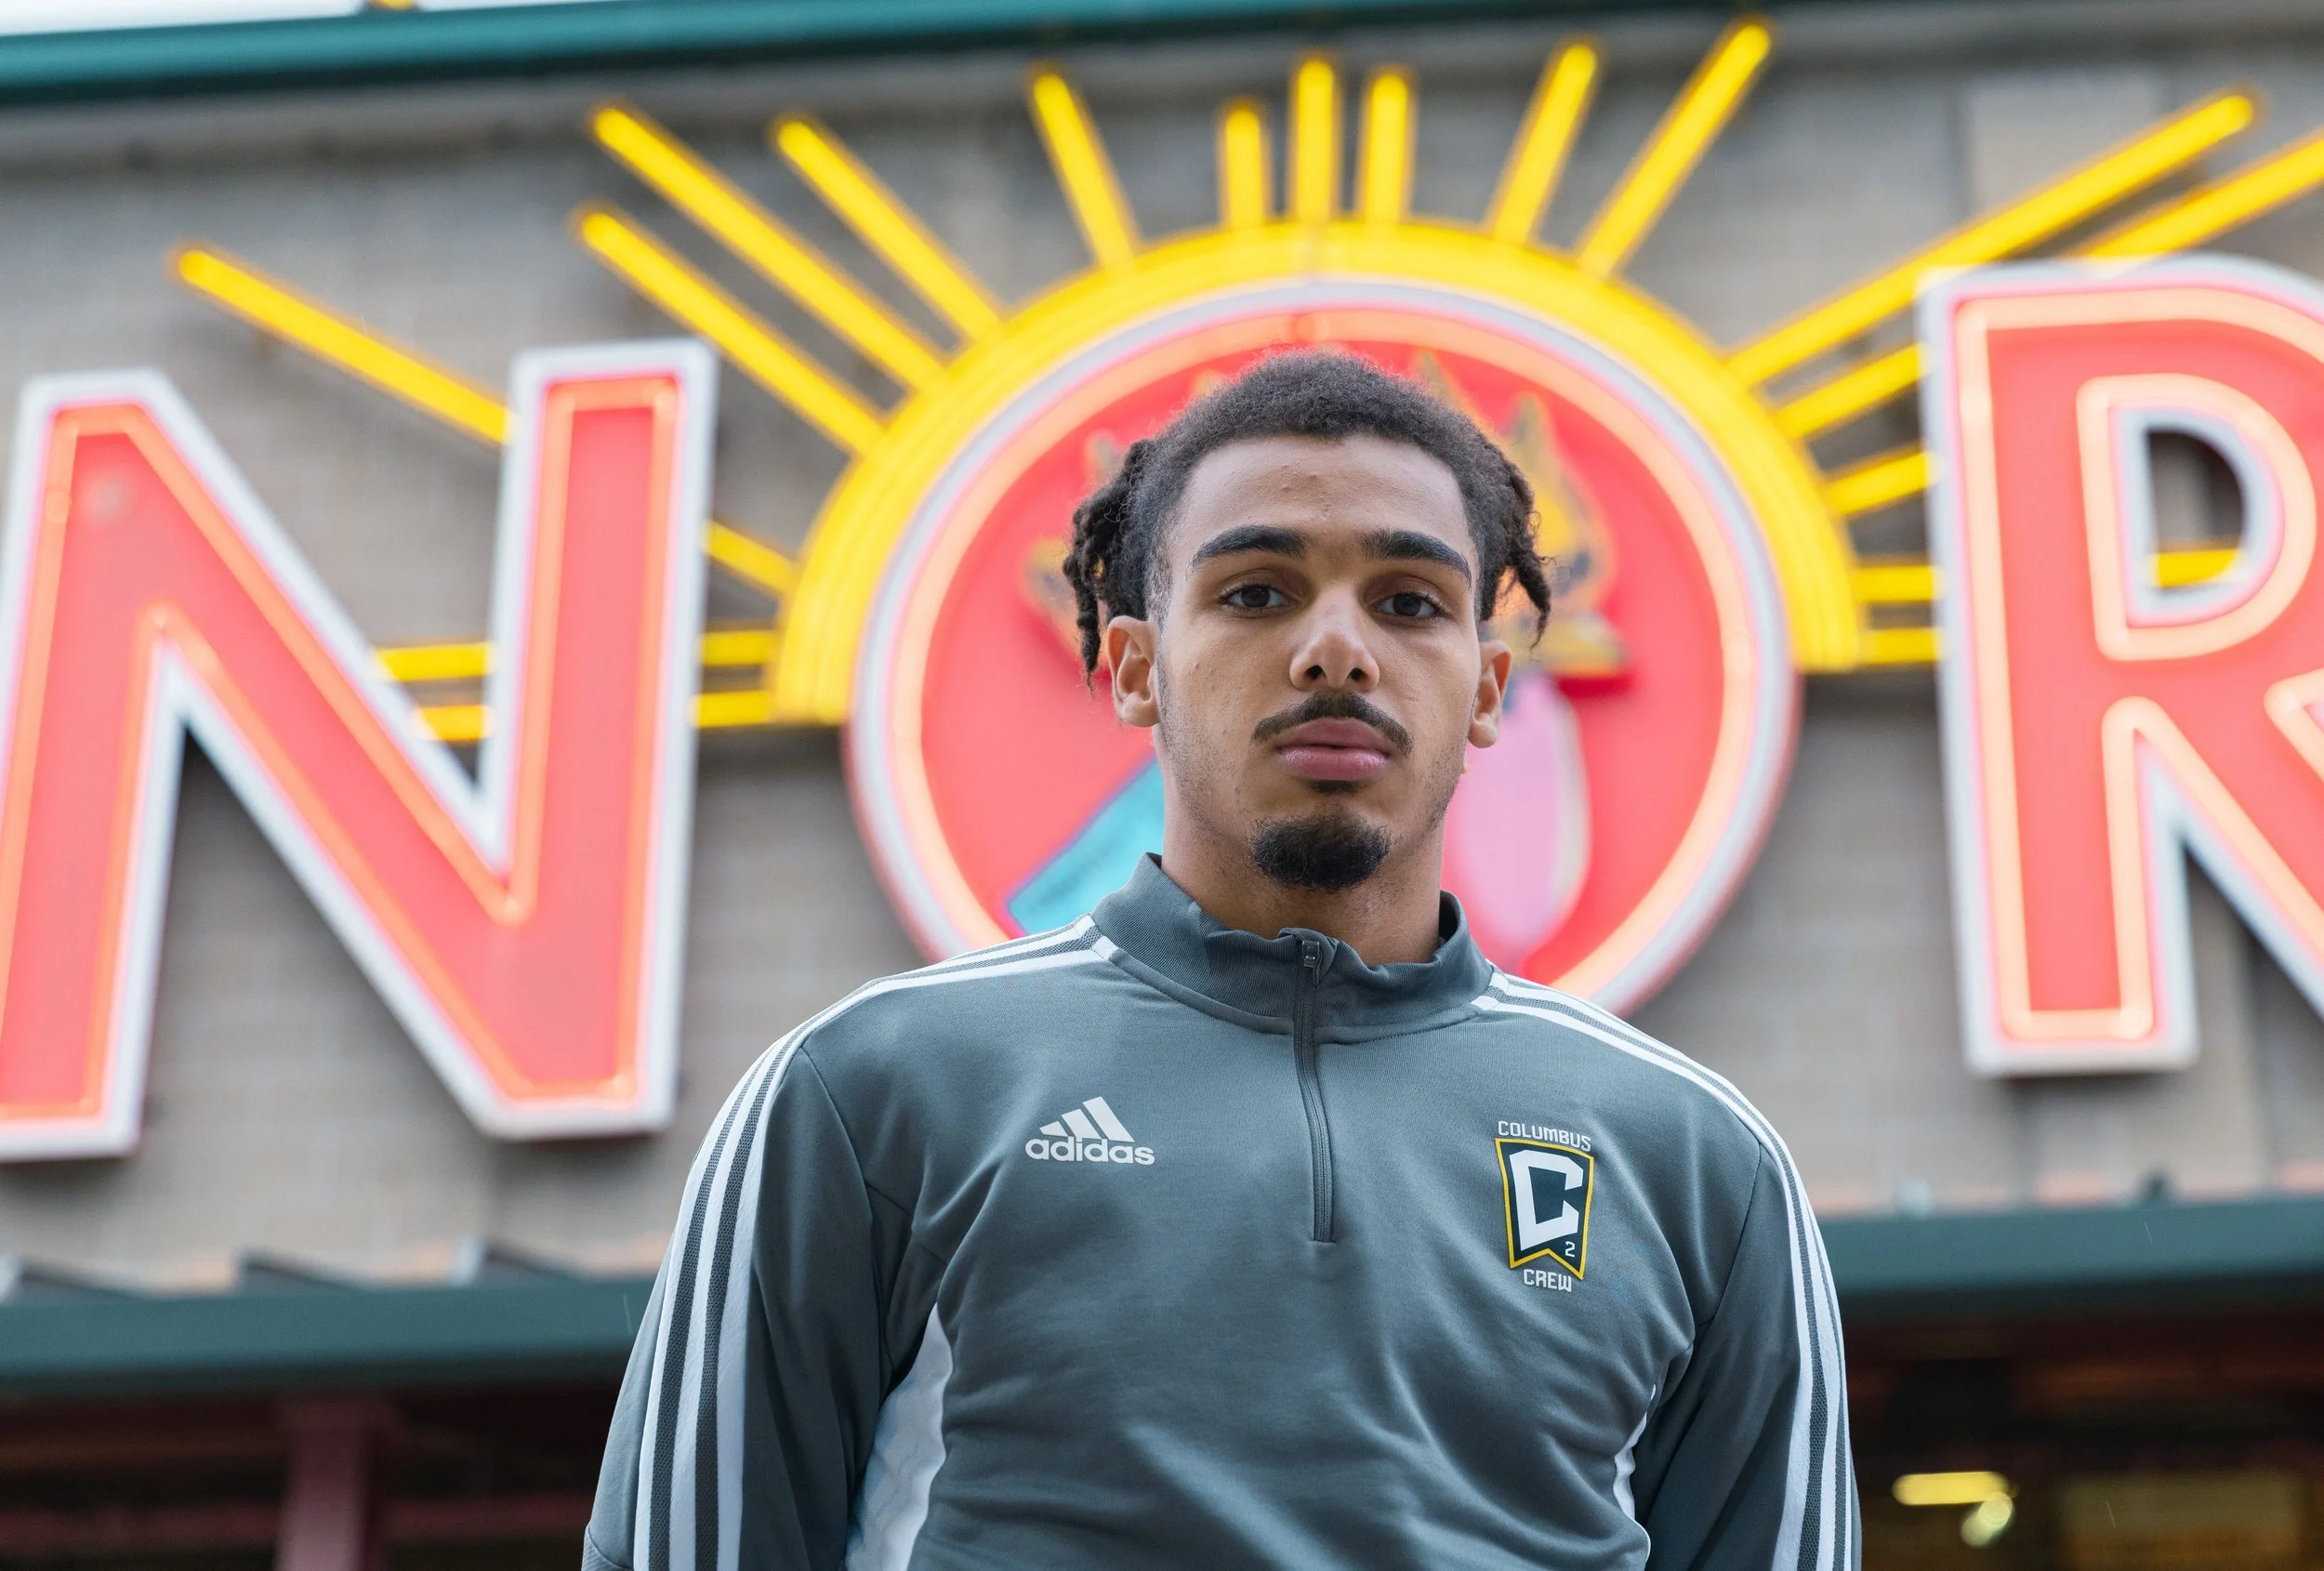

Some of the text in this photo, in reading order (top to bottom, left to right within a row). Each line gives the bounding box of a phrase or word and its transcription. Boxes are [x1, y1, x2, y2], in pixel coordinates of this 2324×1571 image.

[1024, 1135, 1155, 1166] adidas
[1498, 1120, 1591, 1152] COLUMBUS
[1509, 1149, 1584, 1251] C
[1565, 1241, 1576, 1258] 2
[1523, 1268, 1572, 1293] CREW
